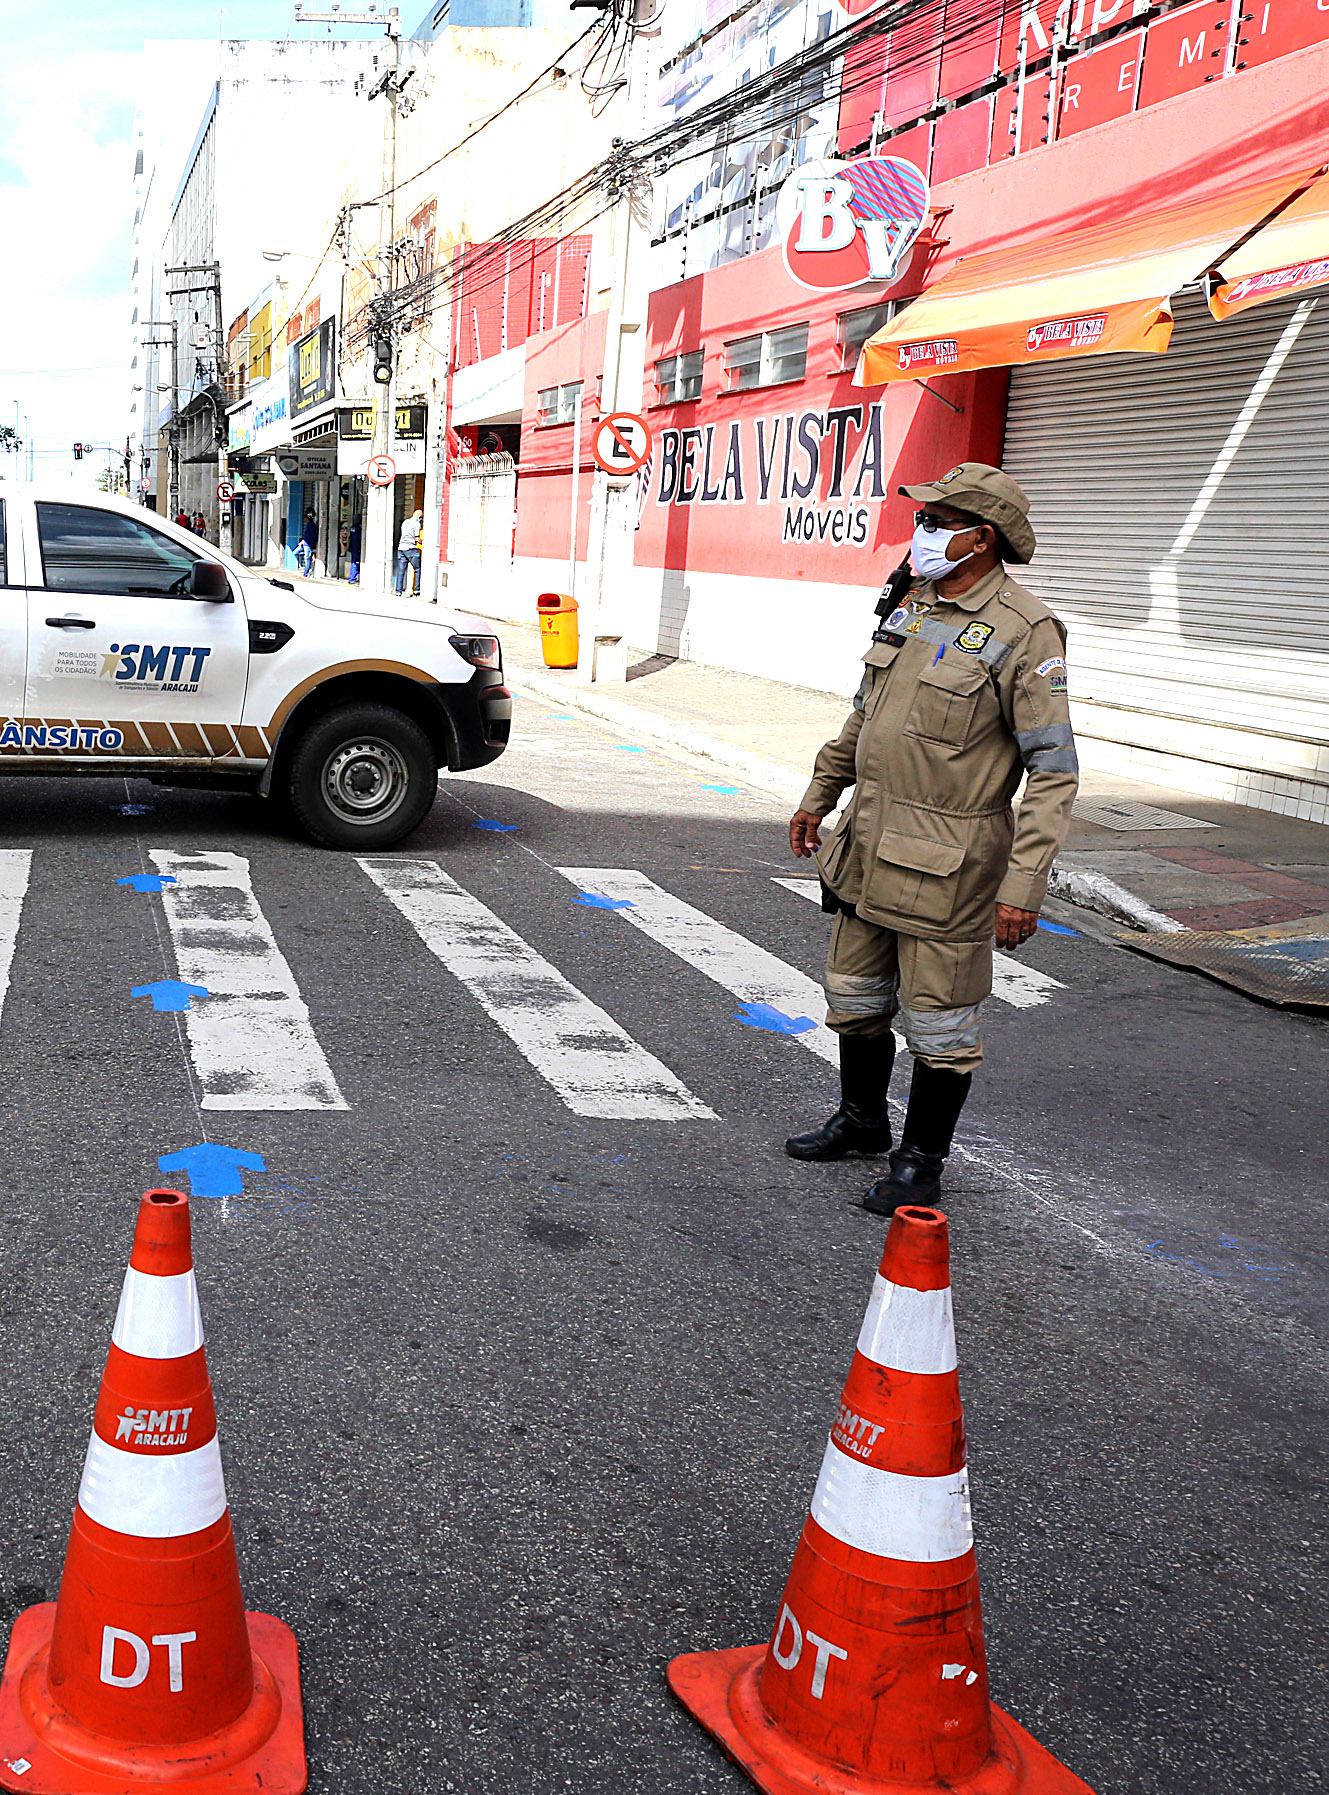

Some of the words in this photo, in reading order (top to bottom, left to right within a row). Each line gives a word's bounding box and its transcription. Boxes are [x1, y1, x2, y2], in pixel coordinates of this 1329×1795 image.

[1044, 322, 1072, 340] BELA
[1073, 318, 1105, 336] VISTA
[912, 344, 933, 361] BELA
[933, 341, 958, 356] VISTA
[658, 423, 744, 502] BELA
[757, 405, 886, 499] VISTA
[783, 500, 868, 543] Móveis
[58, 651, 97, 659] MOBILIDADE
[65, 666, 97, 675] CIDADÃOS
[160, 683, 199, 693] ARACAJU
[135, 1431, 188, 1446] ARACAJU
[100, 1625, 197, 1693] DT
[773, 1602, 848, 1700] DT
